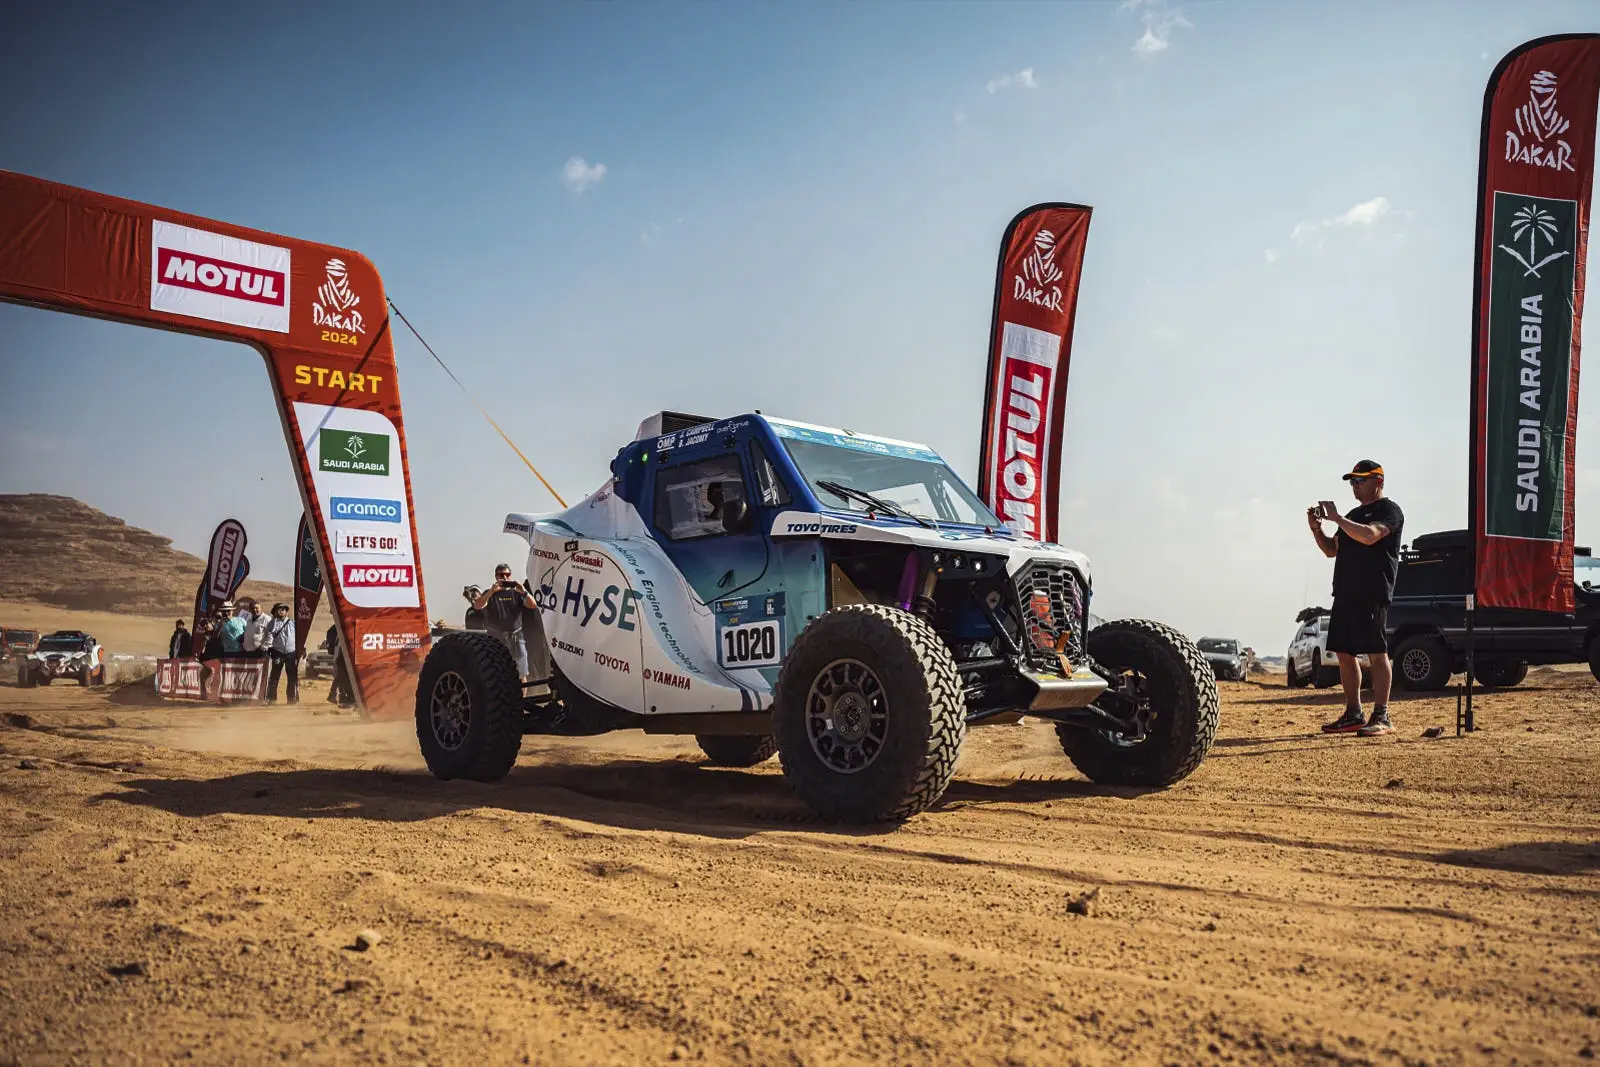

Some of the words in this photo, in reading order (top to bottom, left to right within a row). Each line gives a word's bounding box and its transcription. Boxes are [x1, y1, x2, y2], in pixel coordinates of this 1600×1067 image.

[1505, 131, 1576, 172] DAKAR
[164, 256, 279, 299] MOTUL
[1014, 275, 1064, 313] DAKAR
[313, 302, 366, 334] DAKAR
[321, 331, 357, 345] 2024
[1520, 294, 1543, 411] ARABIA
[296, 365, 382, 393] START
[657, 436, 676, 449] OMP
[1003, 373, 1044, 540] MOTUL
[323, 459, 350, 469] SAUDI
[352, 462, 385, 471] ARABIA
[1516, 419, 1541, 512] SAUDI
[336, 503, 397, 517] aramco
[787, 523, 820, 533] TOYO
[820, 524, 858, 533] TIRES
[346, 536, 377, 549] LET'S
[379, 537, 398, 550] GO!
[216, 528, 238, 590] MOTUL
[570, 551, 603, 568] Kawasaki
[348, 569, 409, 582] MOTUL
[562, 576, 643, 632] HySE
[641, 579, 664, 619] Engine
[658, 620, 703, 675] technology
[557, 640, 584, 657] SUZUKI
[724, 626, 775, 662] 1020
[594, 652, 631, 674] TOYOTA
[653, 670, 691, 690] YAMAHA
